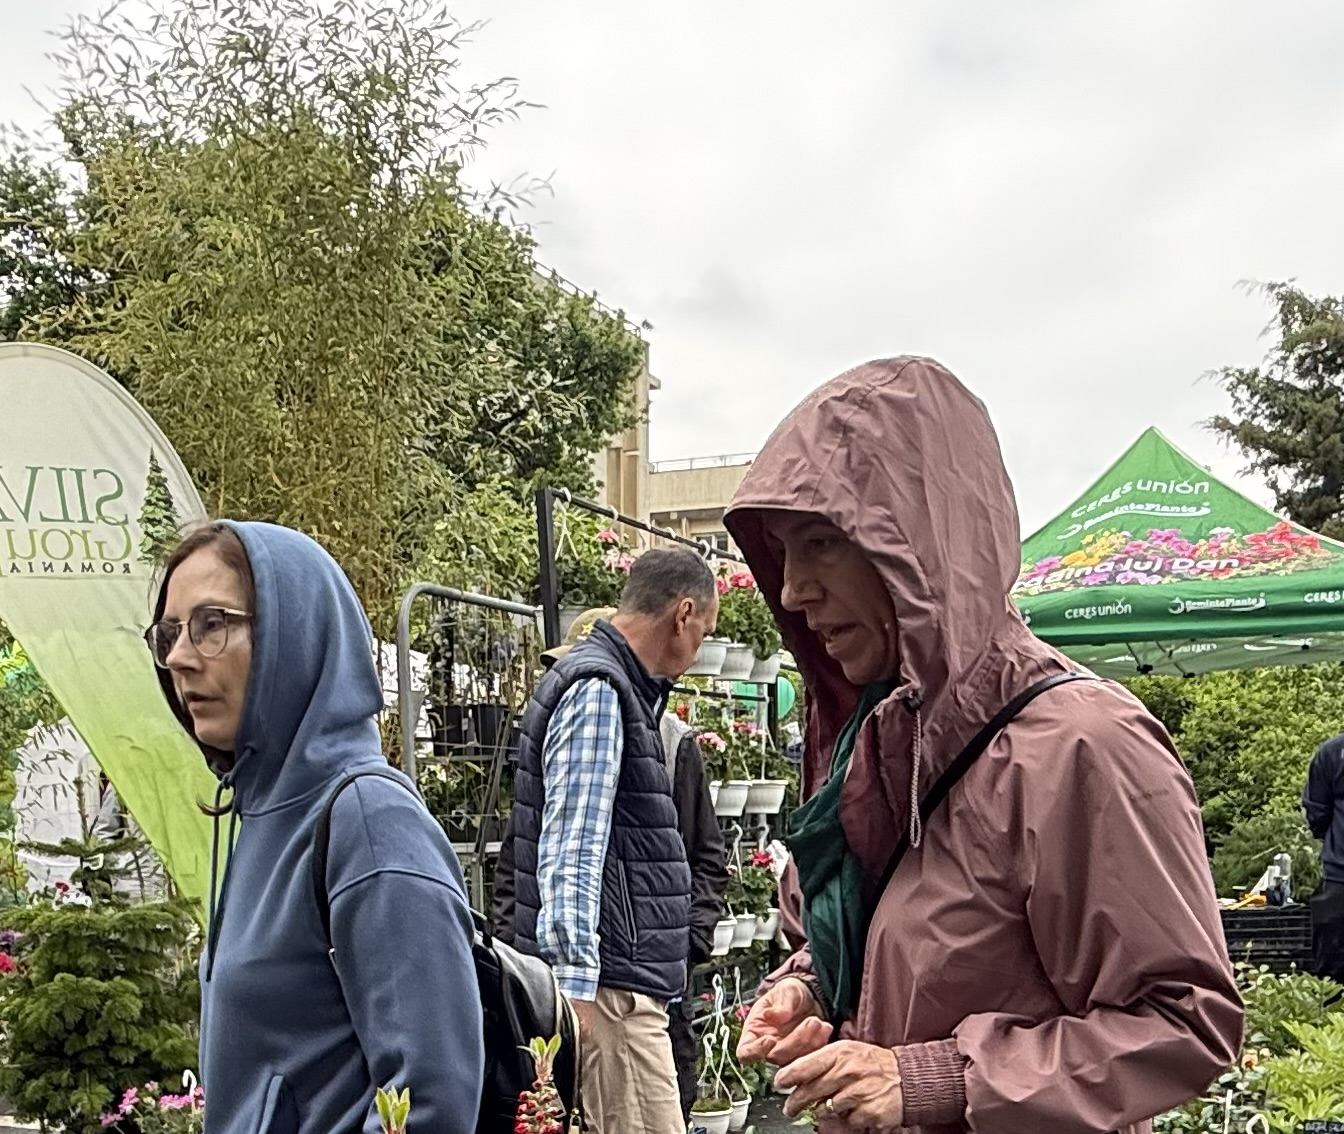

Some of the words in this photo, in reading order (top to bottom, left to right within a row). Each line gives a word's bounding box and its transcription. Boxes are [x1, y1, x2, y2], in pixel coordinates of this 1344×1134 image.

[1070, 481, 1133, 518] CERES
[1171, 557, 1240, 573] Dan
[1303, 589, 1341, 604] CERES
[1064, 605, 1097, 620] CERES
